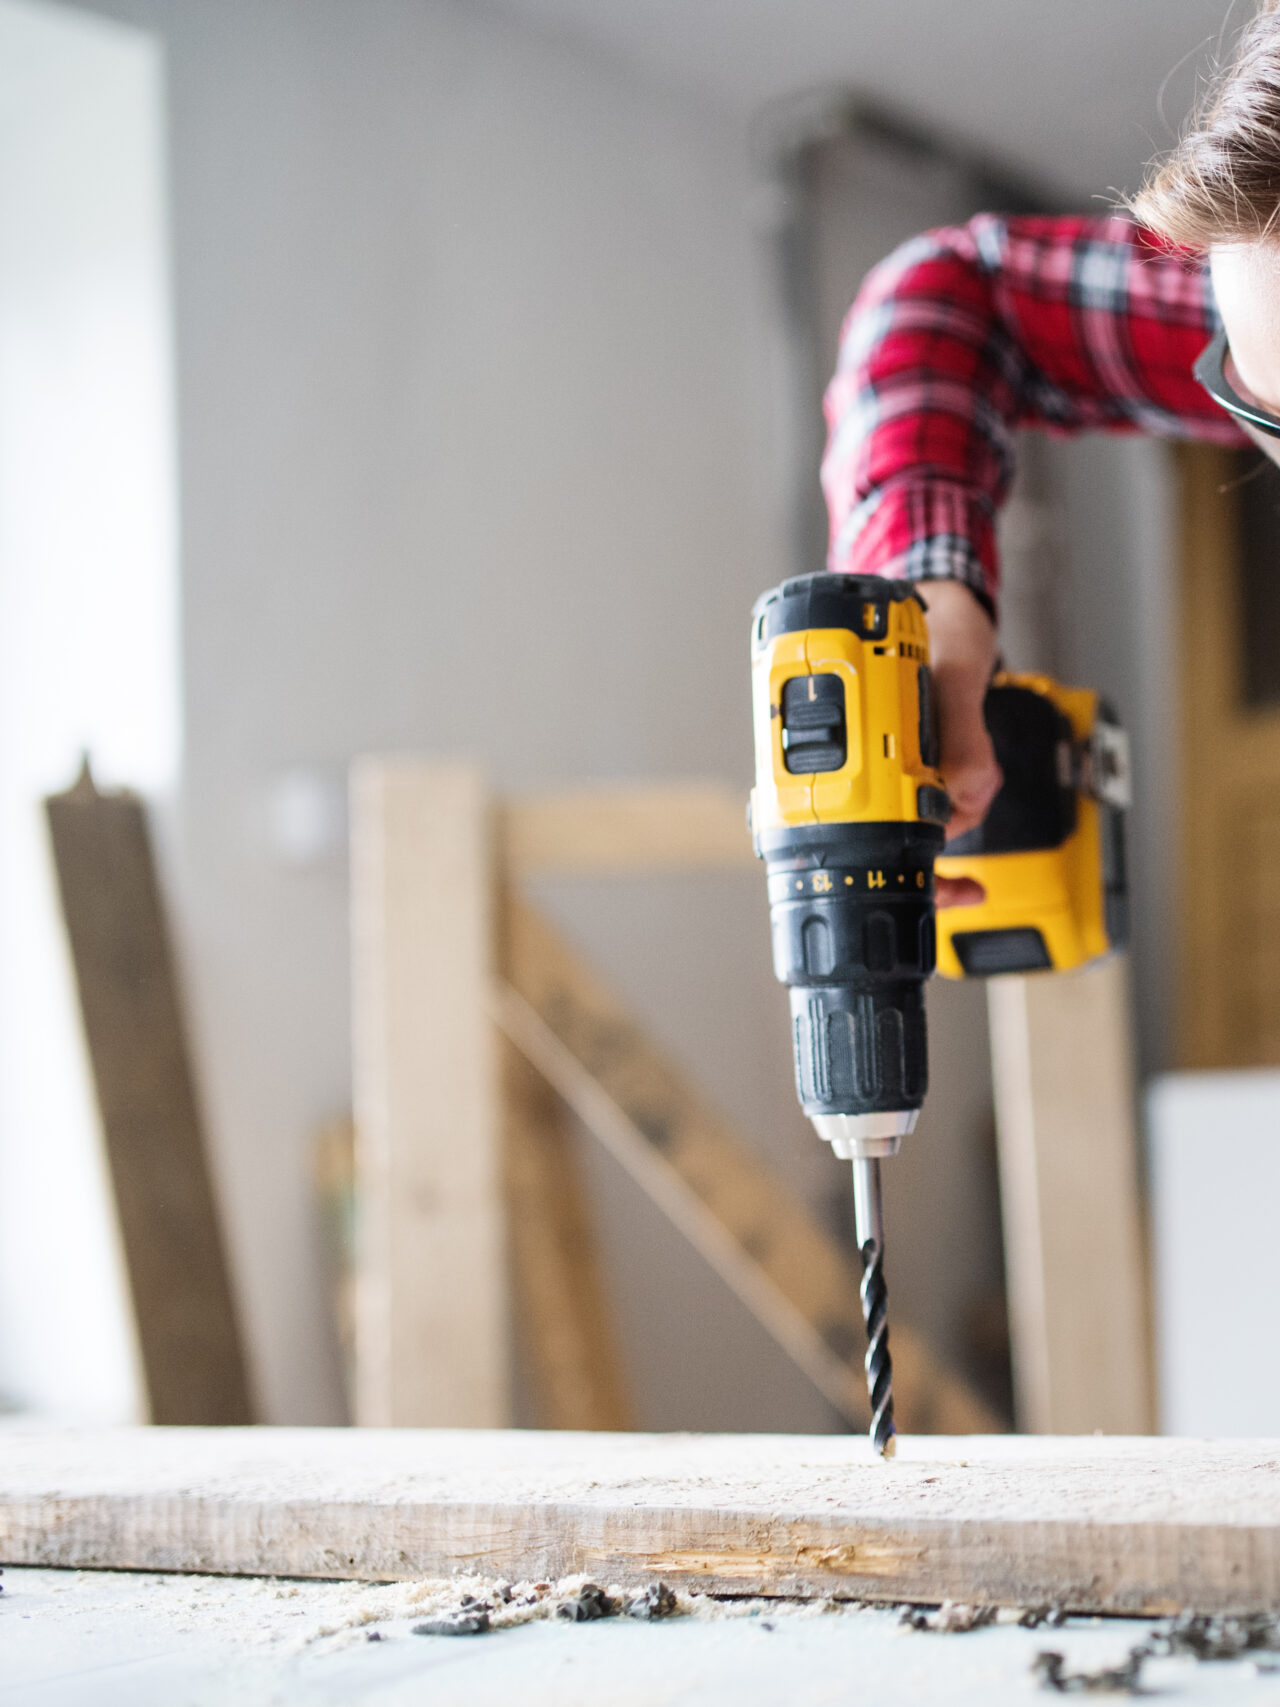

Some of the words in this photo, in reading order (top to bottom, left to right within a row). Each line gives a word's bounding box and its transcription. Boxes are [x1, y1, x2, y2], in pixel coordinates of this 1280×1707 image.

[808, 677, 818, 702] 1
[812, 874, 833, 892] 13
[867, 870, 887, 889] 11
